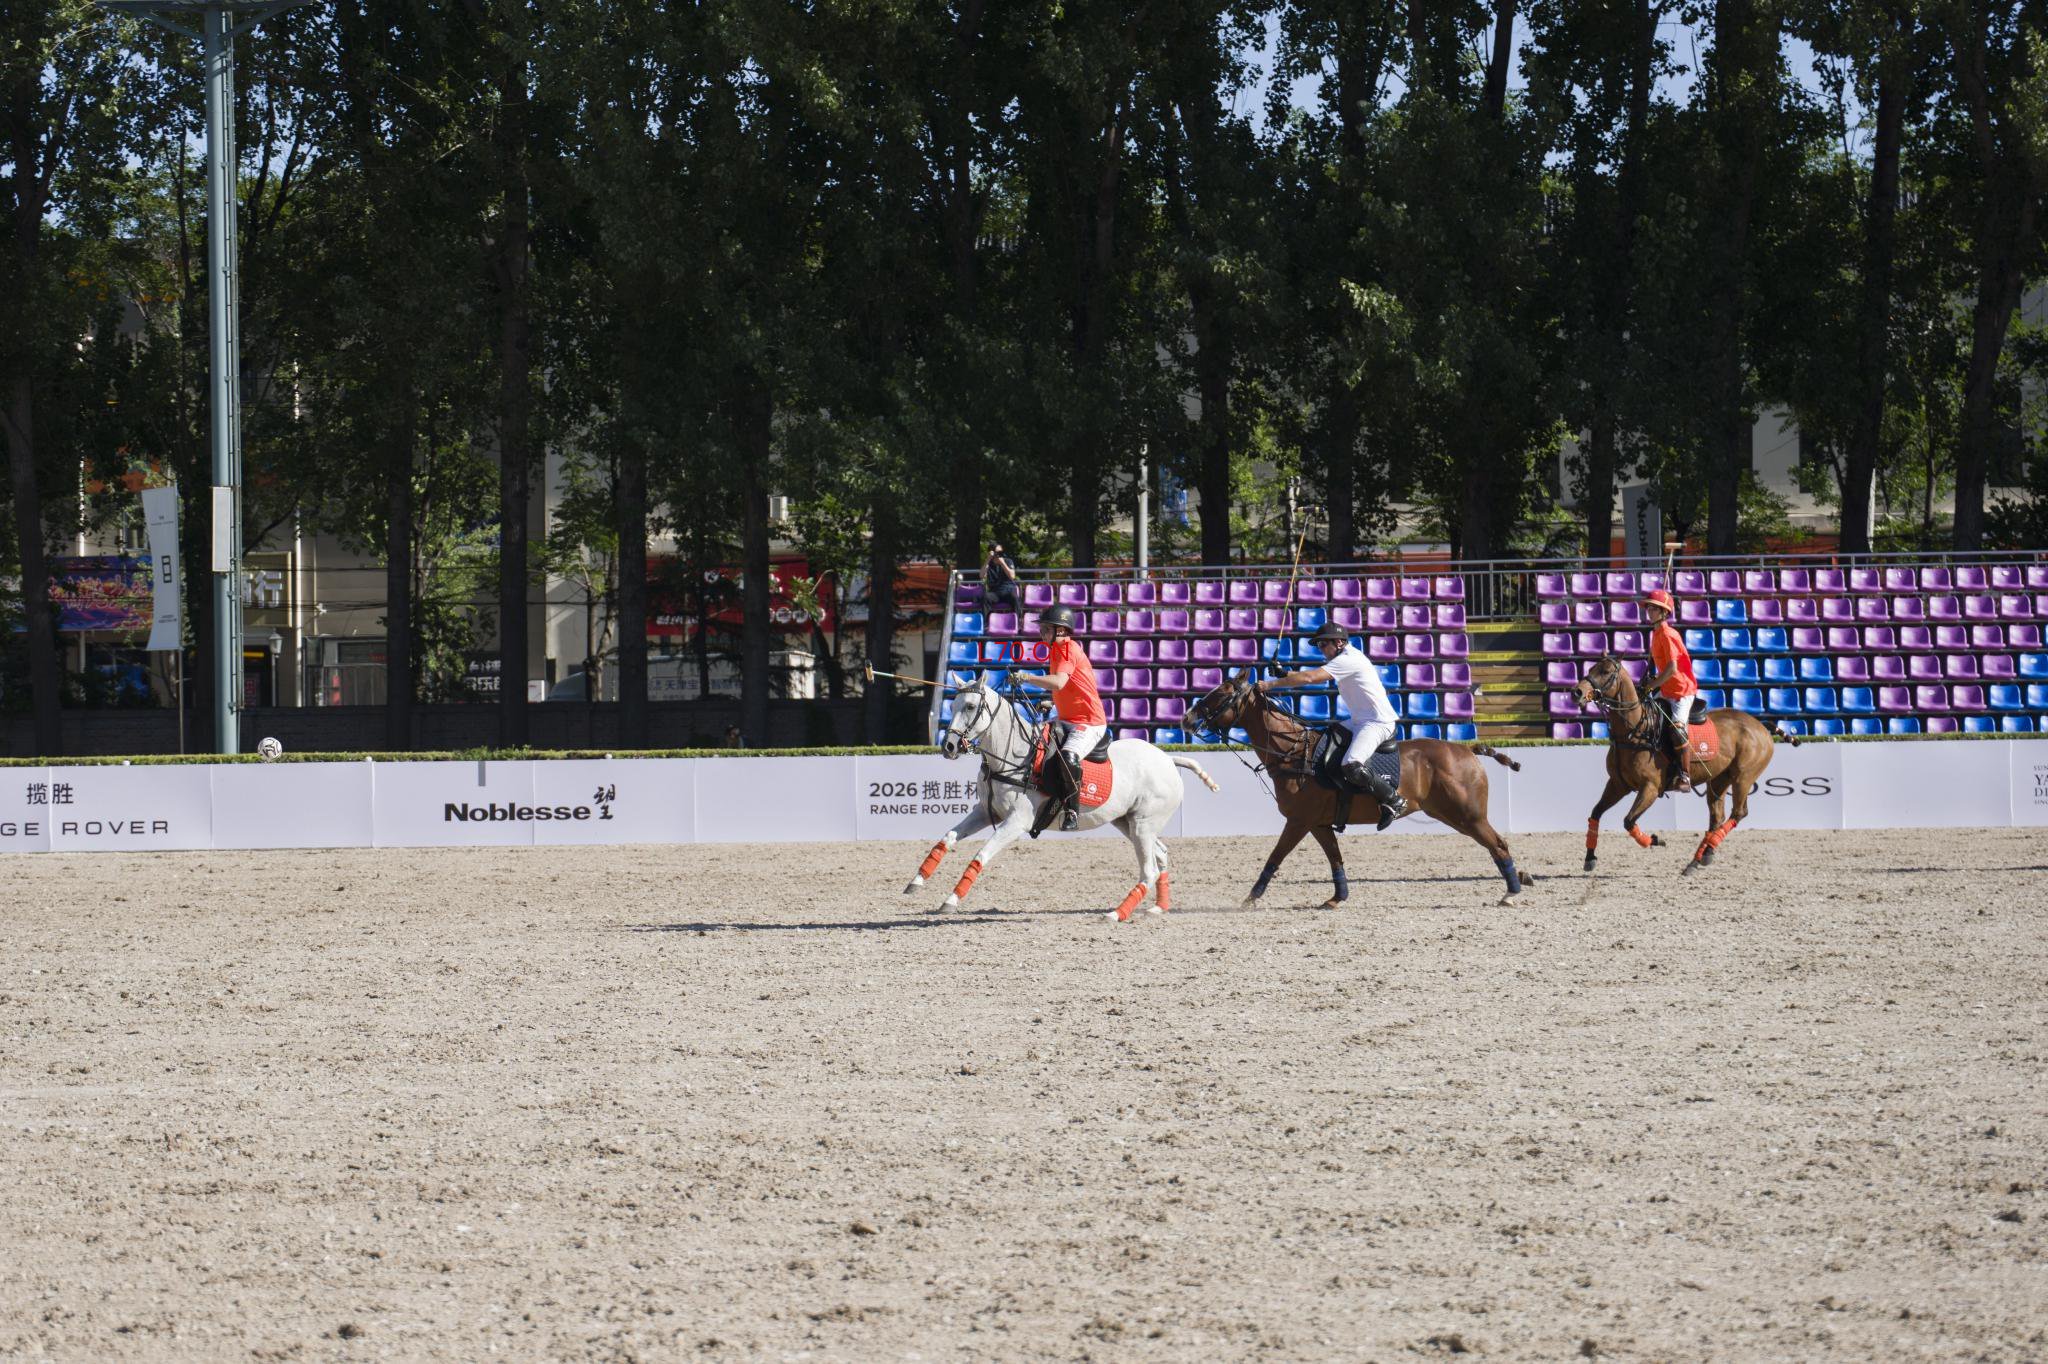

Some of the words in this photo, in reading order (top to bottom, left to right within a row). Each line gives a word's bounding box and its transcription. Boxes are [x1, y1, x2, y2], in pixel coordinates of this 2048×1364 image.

[27, 783, 74, 805] 揽胜
[869, 782, 918, 797] 2026
[444, 802, 591, 822] Noblesse
[870, 804, 918, 815] RANGE
[921, 804, 969, 814] ROVER
[62, 821, 168, 836] ROVER
